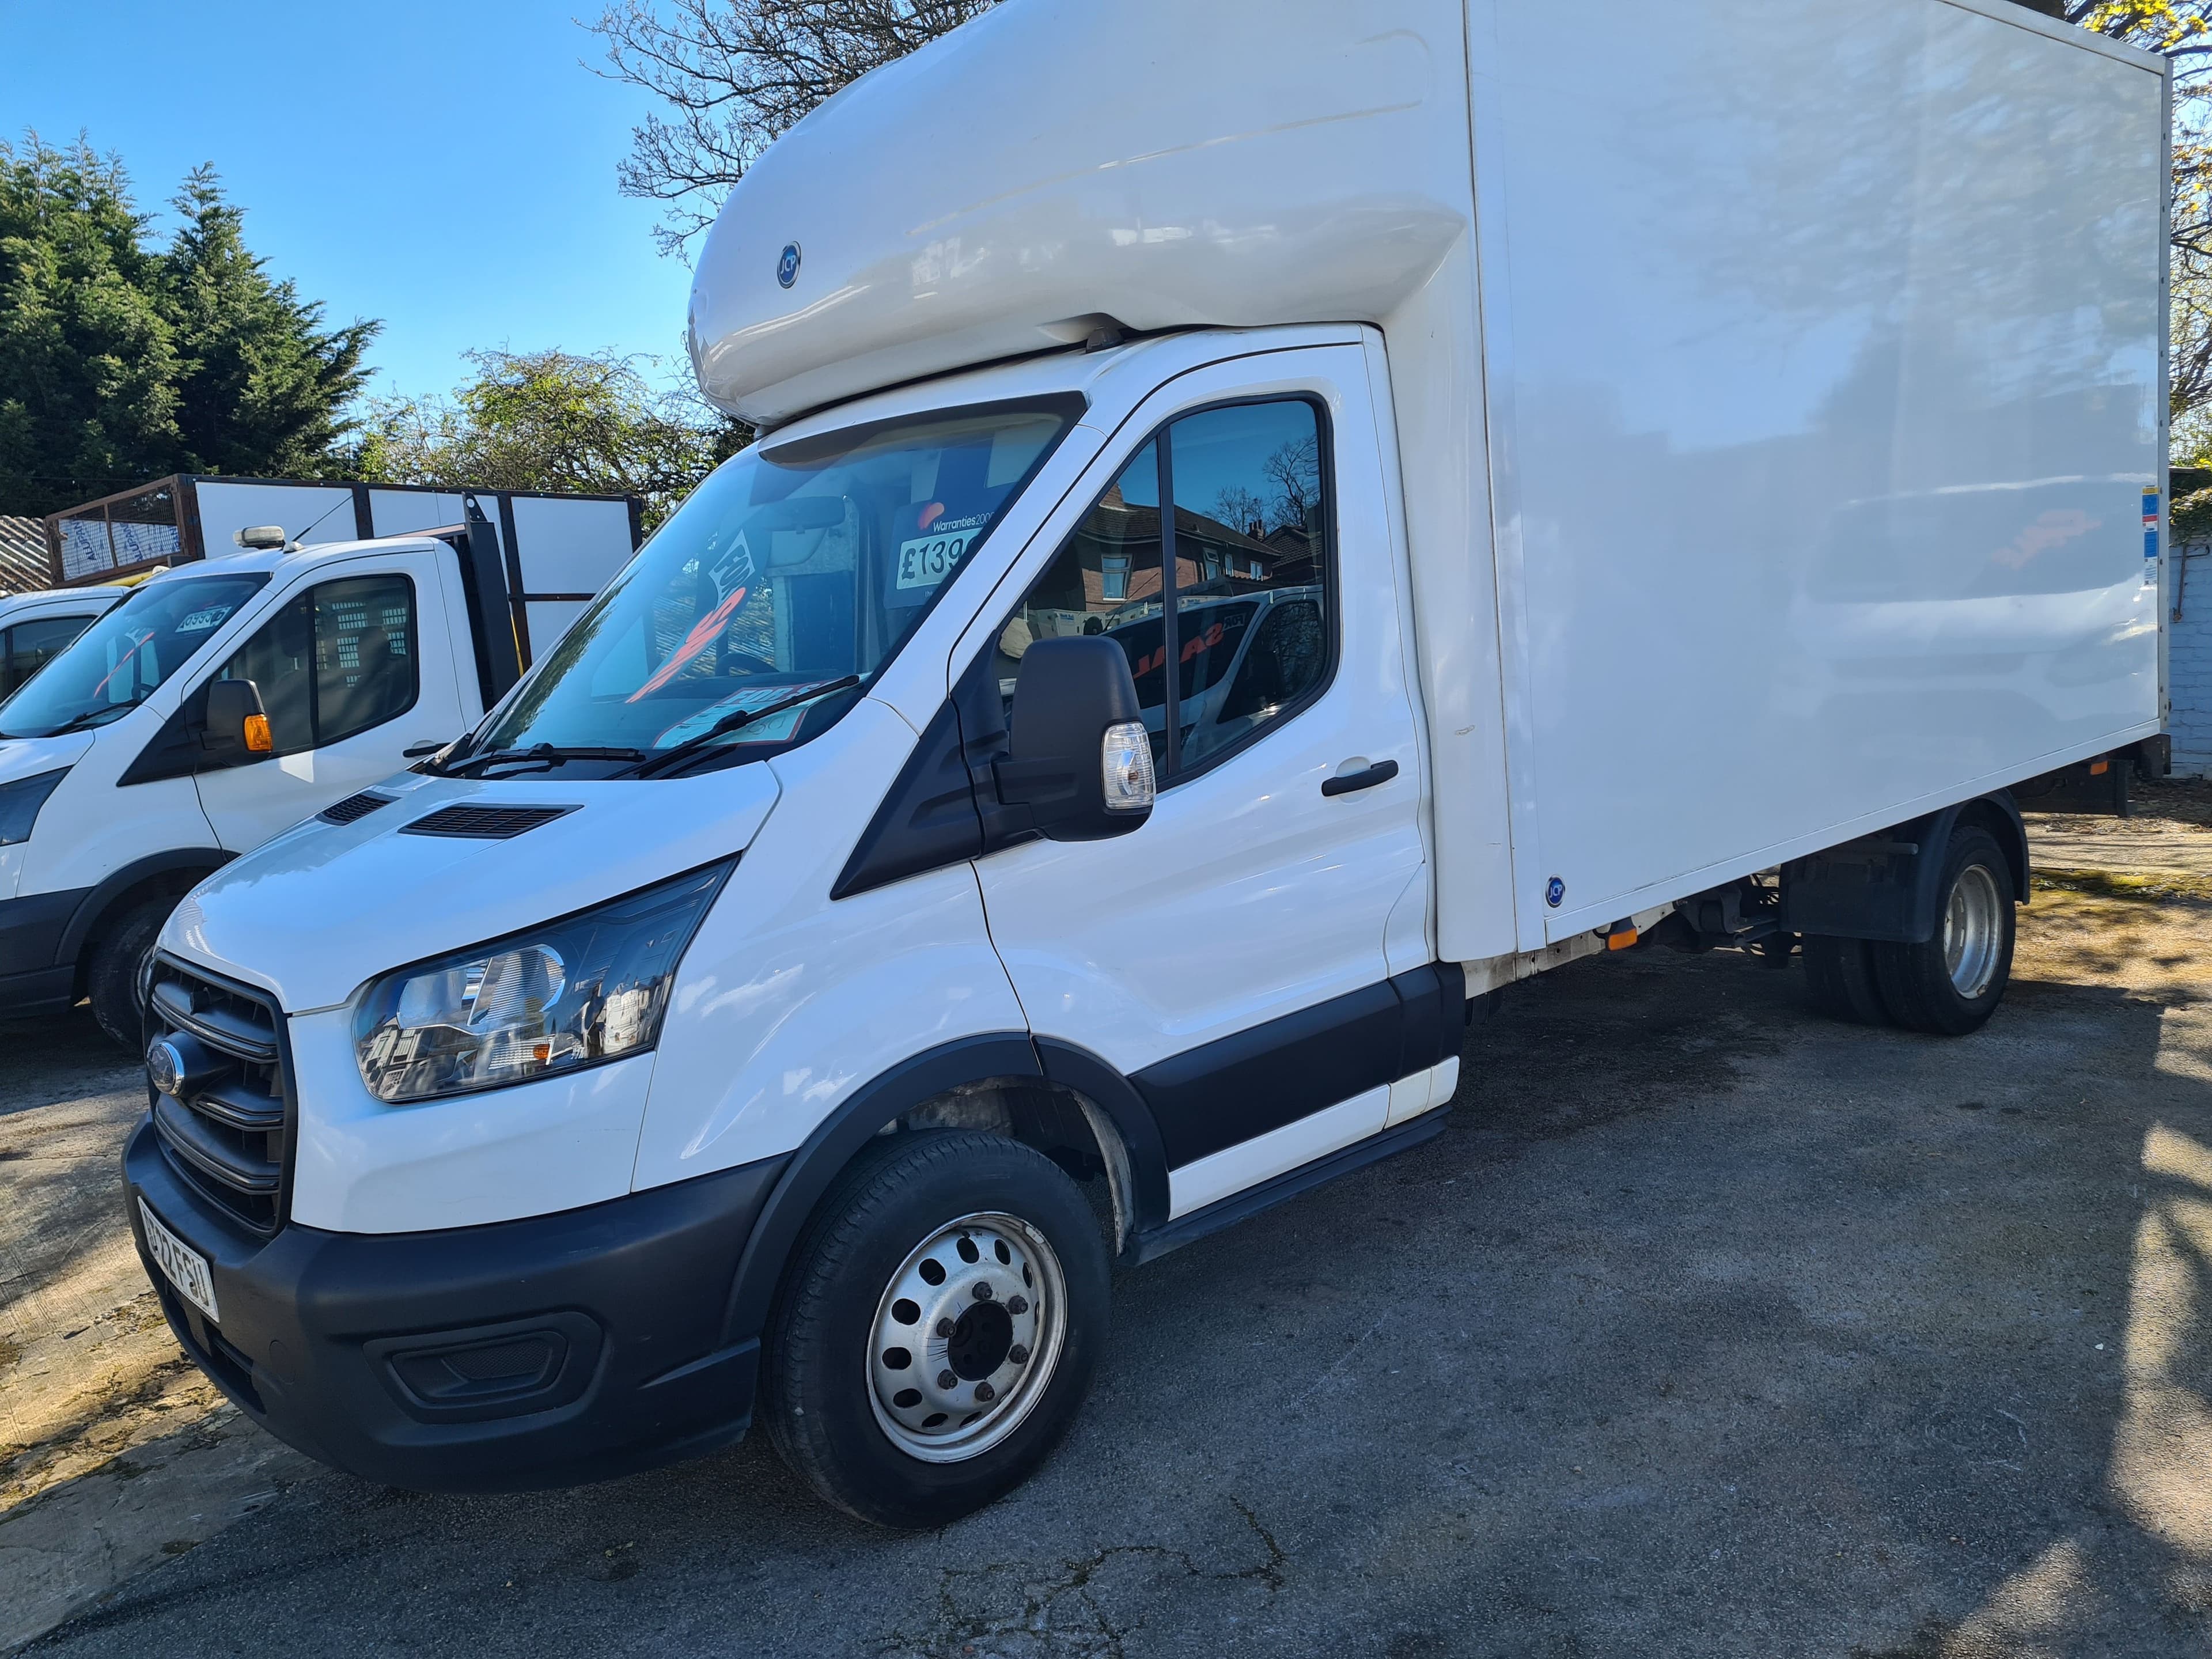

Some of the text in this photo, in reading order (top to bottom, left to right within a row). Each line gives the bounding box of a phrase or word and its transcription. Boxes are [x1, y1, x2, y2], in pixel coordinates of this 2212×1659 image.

[714, 543, 749, 602] FOR
[723, 687, 793, 704] FOR
[1550, 884, 1562, 898] JCP
[172, 1243, 210, 1307] FSU
